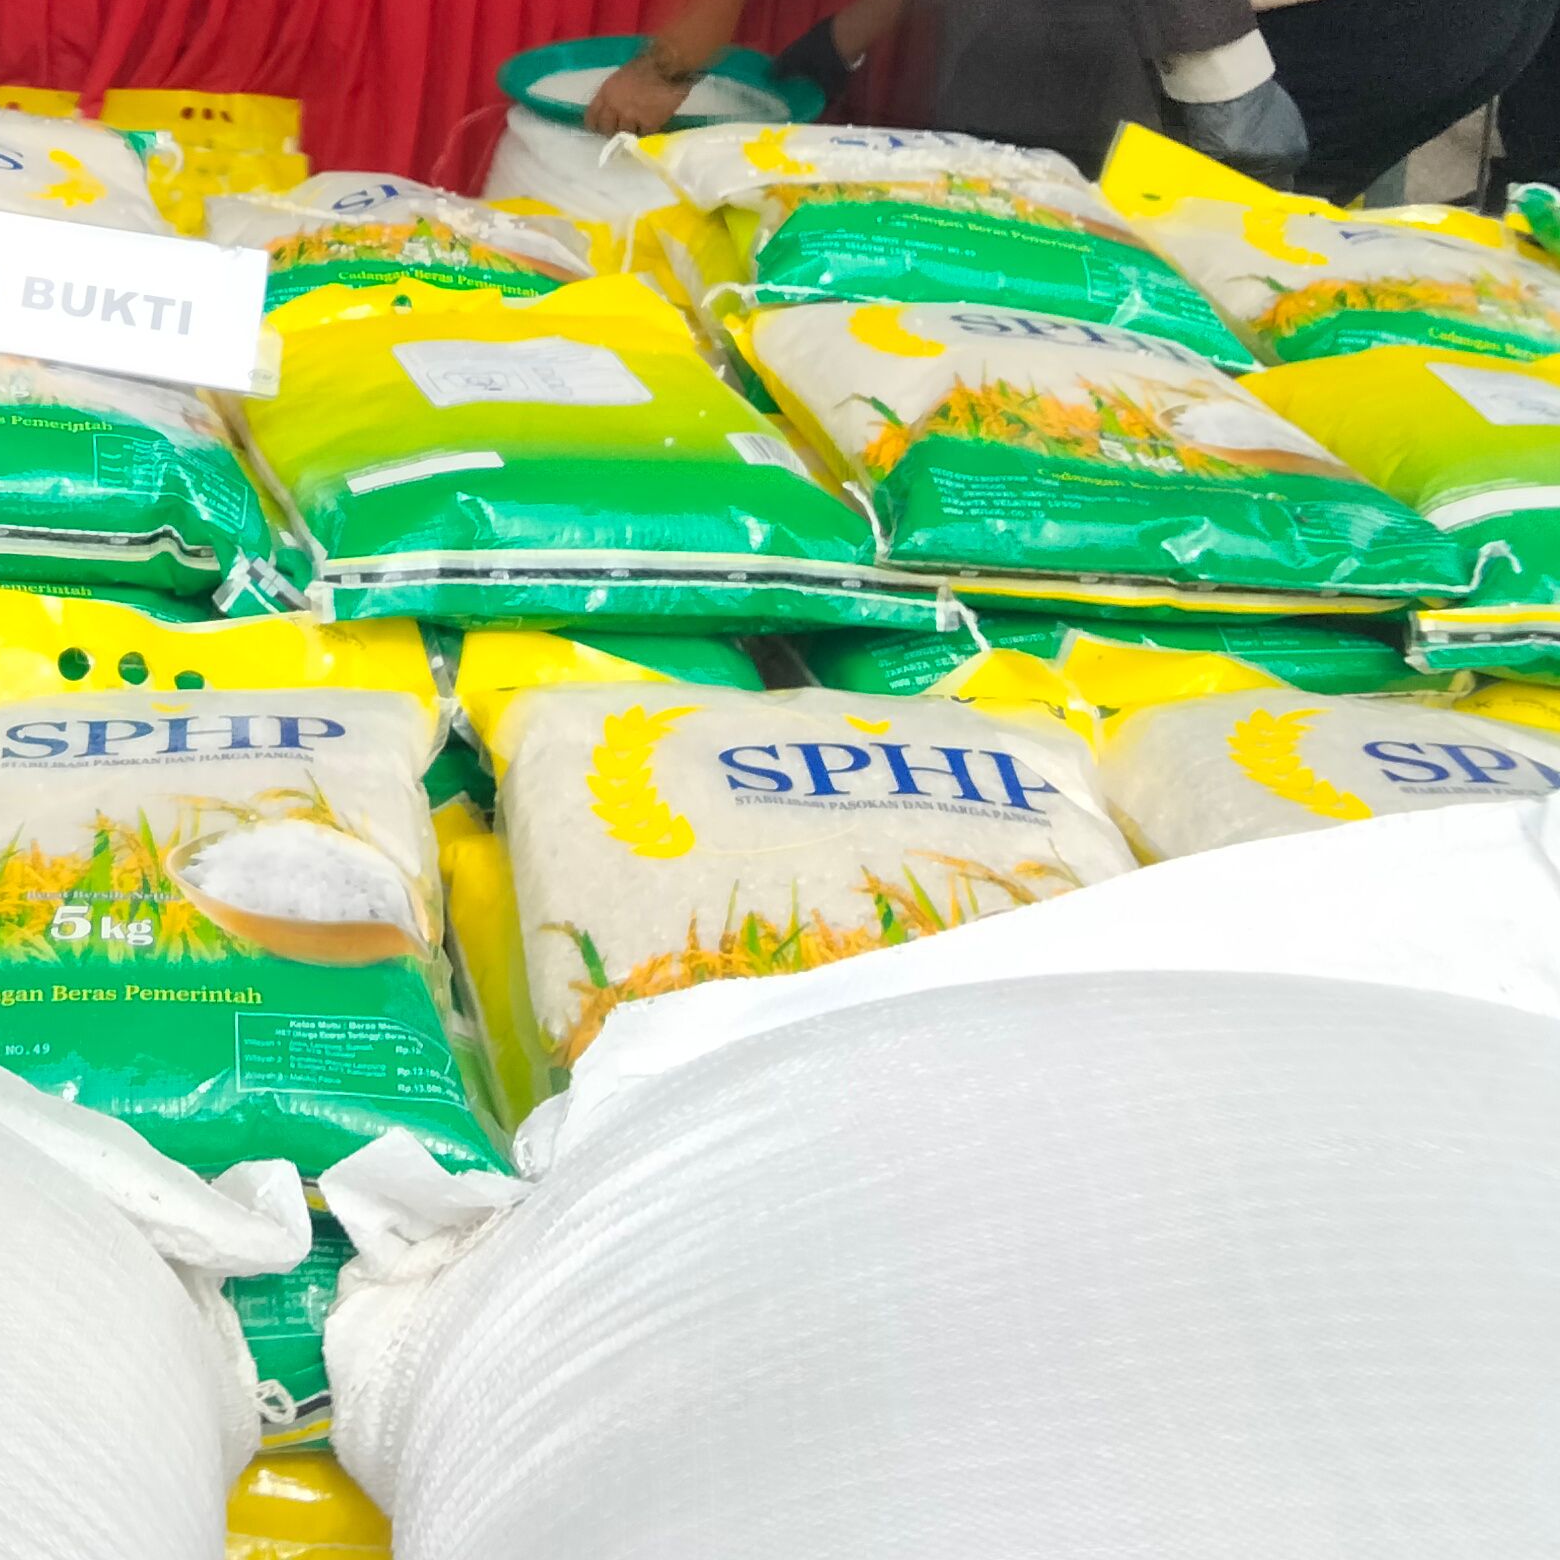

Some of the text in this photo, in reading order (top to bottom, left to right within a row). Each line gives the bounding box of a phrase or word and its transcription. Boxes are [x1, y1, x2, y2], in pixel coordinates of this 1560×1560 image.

[20, 278, 195, 338] BUKTI
[0, 715, 347, 760] SPHP
[93, 755, 163, 767] PASOKAN
[165, 754, 196, 765] DAN
[198, 752, 252, 763] HARGA
[253, 750, 316, 764] PANGAN
[829, 798, 903, 812] PASOKAN
[903, 799, 936, 813] DAN
[939, 801, 992, 819] HARGA
[49, 904, 156, 947] 5 kg
[50, 984, 118, 1004] Beras
[124, 983, 264, 1006] Pemerintah
[5, 1042, 51, 1057] NO.49
